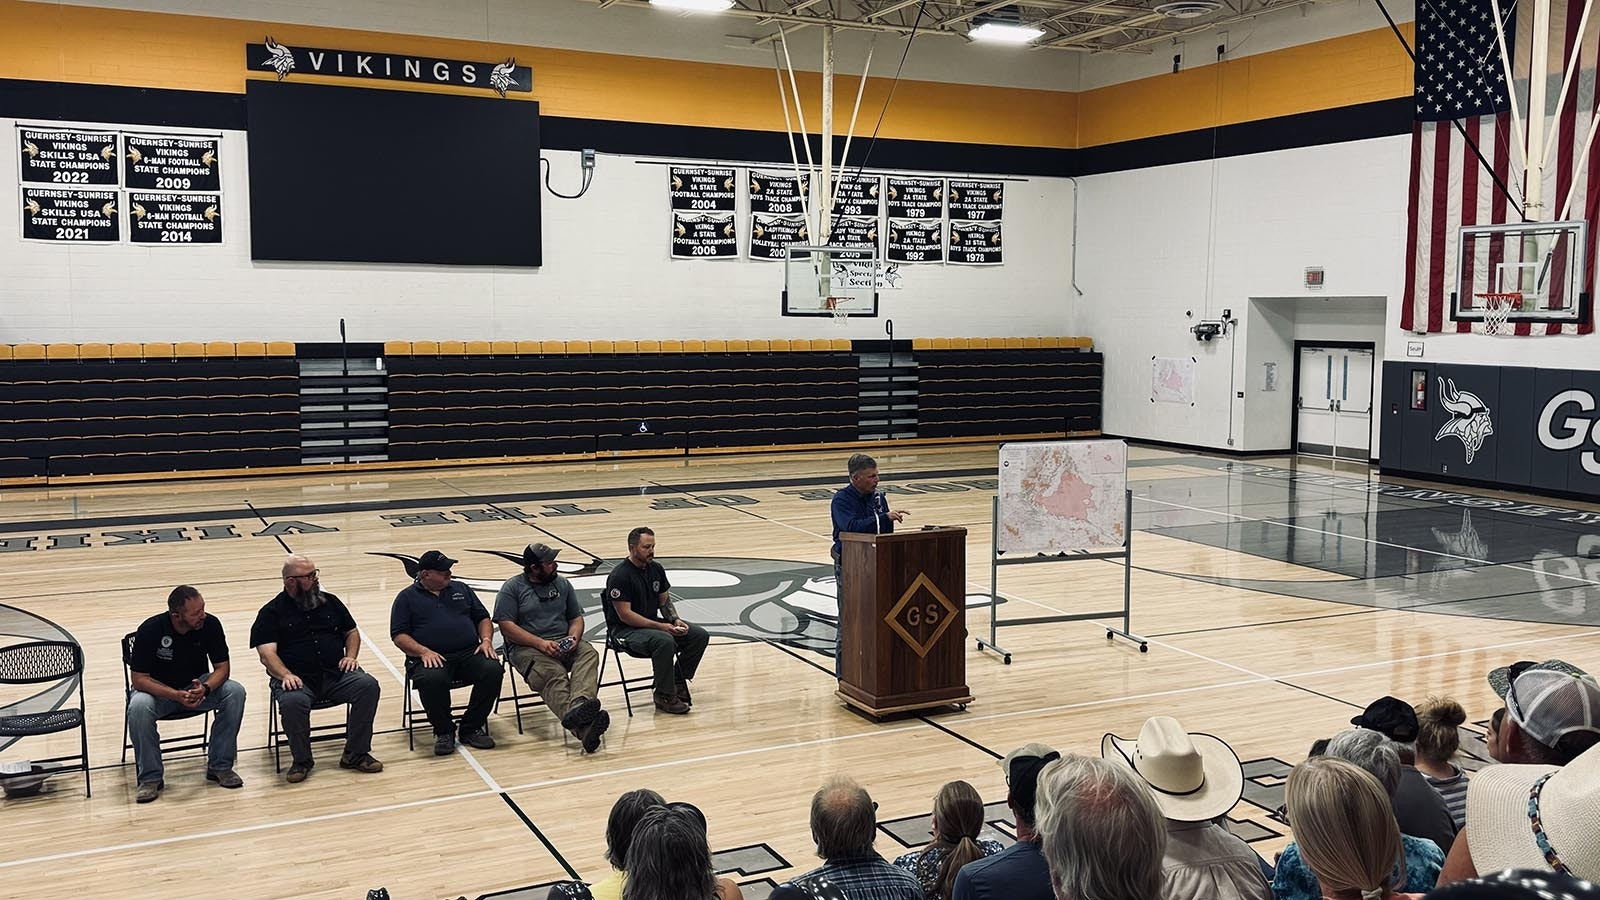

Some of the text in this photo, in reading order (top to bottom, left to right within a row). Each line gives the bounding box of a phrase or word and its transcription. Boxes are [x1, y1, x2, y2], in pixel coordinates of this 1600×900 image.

[308, 51, 477, 84] VIKINGS
[25, 132, 112, 142] GUERNSEY-SUNRISE
[53, 142, 87, 150] VIKINGS
[130, 138, 213, 148] GUERNSEY-SUNRISE
[40, 151, 74, 159] SKILLS
[30, 160, 110, 170] STATE CHAMPIONS
[134, 165, 210, 175] STATE CHAMPIONS
[53, 171, 89, 183] 2022
[156, 177, 191, 189] 2009
[27, 190, 114, 199] GUERNSEY-SUNRISE
[133, 194, 216, 203] GUERNSEY-SUNRISE
[54, 200, 89, 208] VIKINGS
[691, 200, 716, 209] 2004
[768, 203, 792, 212] 2008
[841, 205, 861, 214] 993
[906, 209, 925, 217] 1979
[968, 211, 985, 219] 1977
[32, 217, 111, 227] STATE CHAMPIONS
[56, 228, 89, 239] 2021
[161, 231, 192, 242] 2014
[692, 246, 716, 255] 2006
[769, 248, 785, 257] 200
[906, 252, 924, 260] 1992
[966, 253, 984, 261] 1978
[849, 279, 882, 287] Sectin
[649, 494, 760, 511] OF
[379, 502, 612, 528] THE
[906, 603, 938, 627] GS
